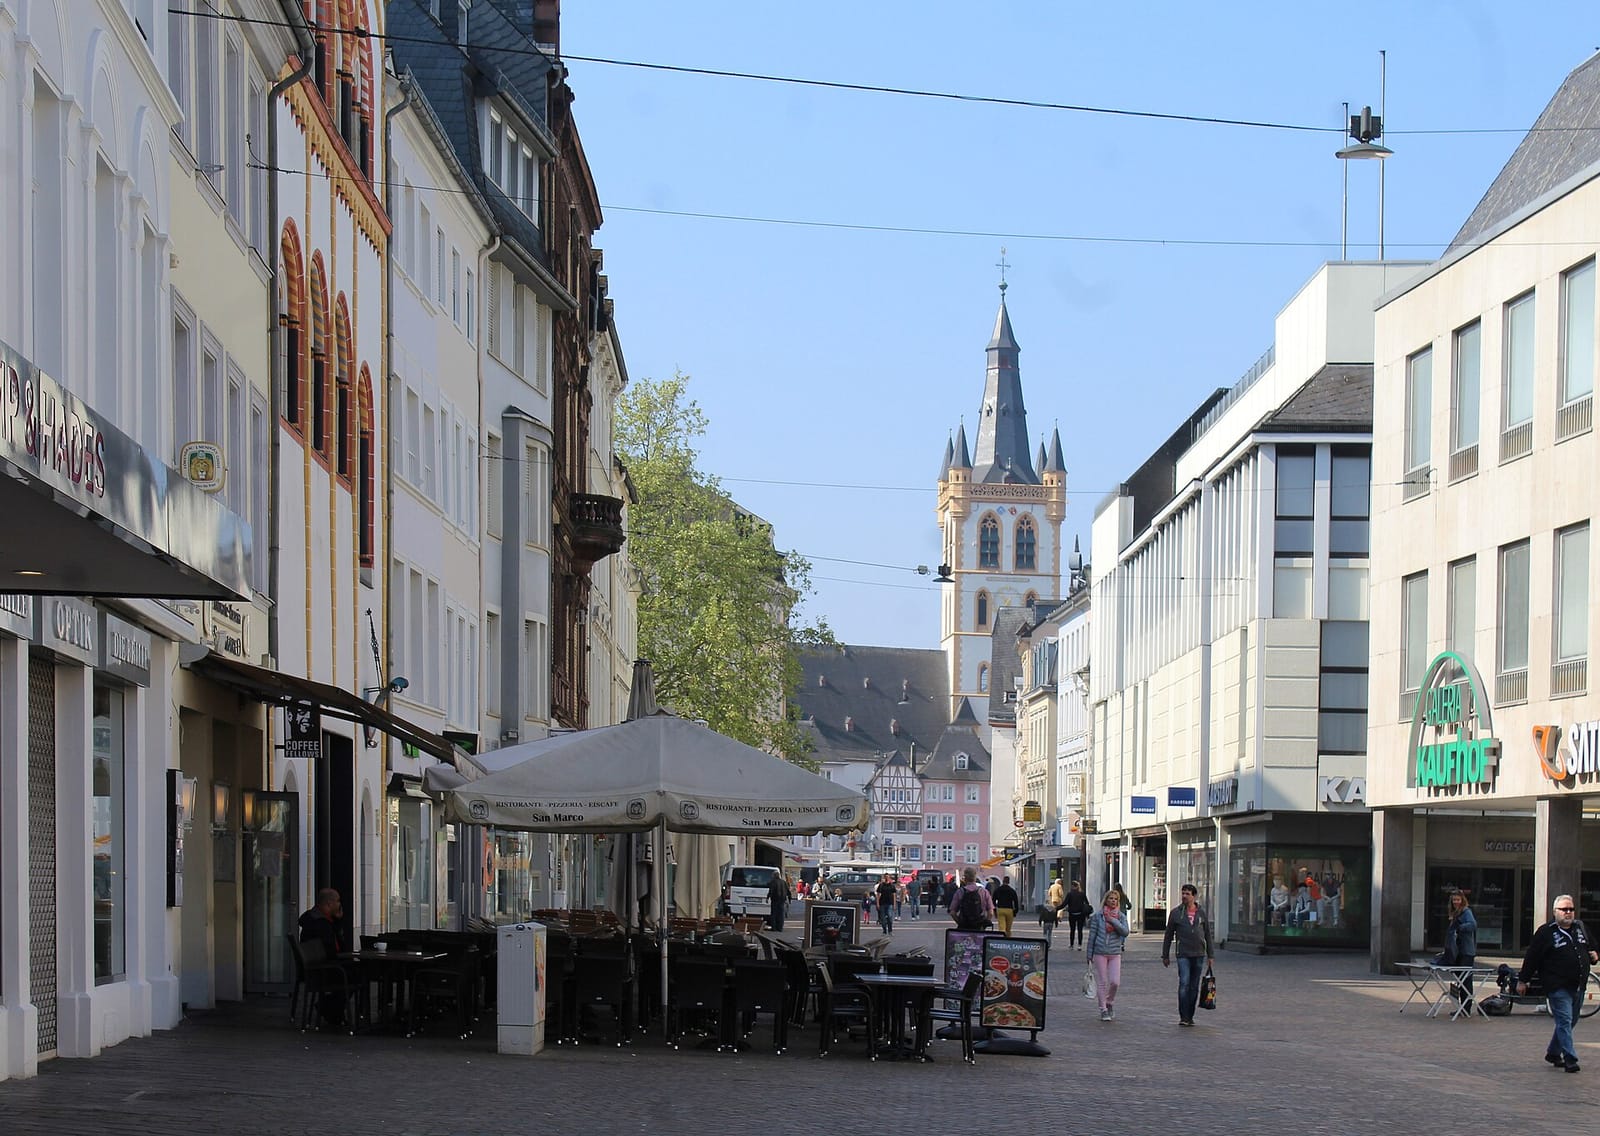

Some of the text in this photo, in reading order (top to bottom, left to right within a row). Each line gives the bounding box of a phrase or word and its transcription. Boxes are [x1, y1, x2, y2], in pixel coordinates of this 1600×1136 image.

[25, 379, 38, 458] &
[42, 390, 105, 498] HADES
[55, 600, 93, 651] OPTIK
[285, 740, 320, 750] COFFEE
[1567, 720, 1600, 776] SAT
[285, 750, 320, 758] FELLOWS
[495, 801, 543, 809] RISTORANTE
[705, 803, 753, 812] RISTORANTE
[758, 806, 792, 814] PIZZERIA
[532, 813, 584, 823] San Marco
[742, 818, 794, 827] San Marco
